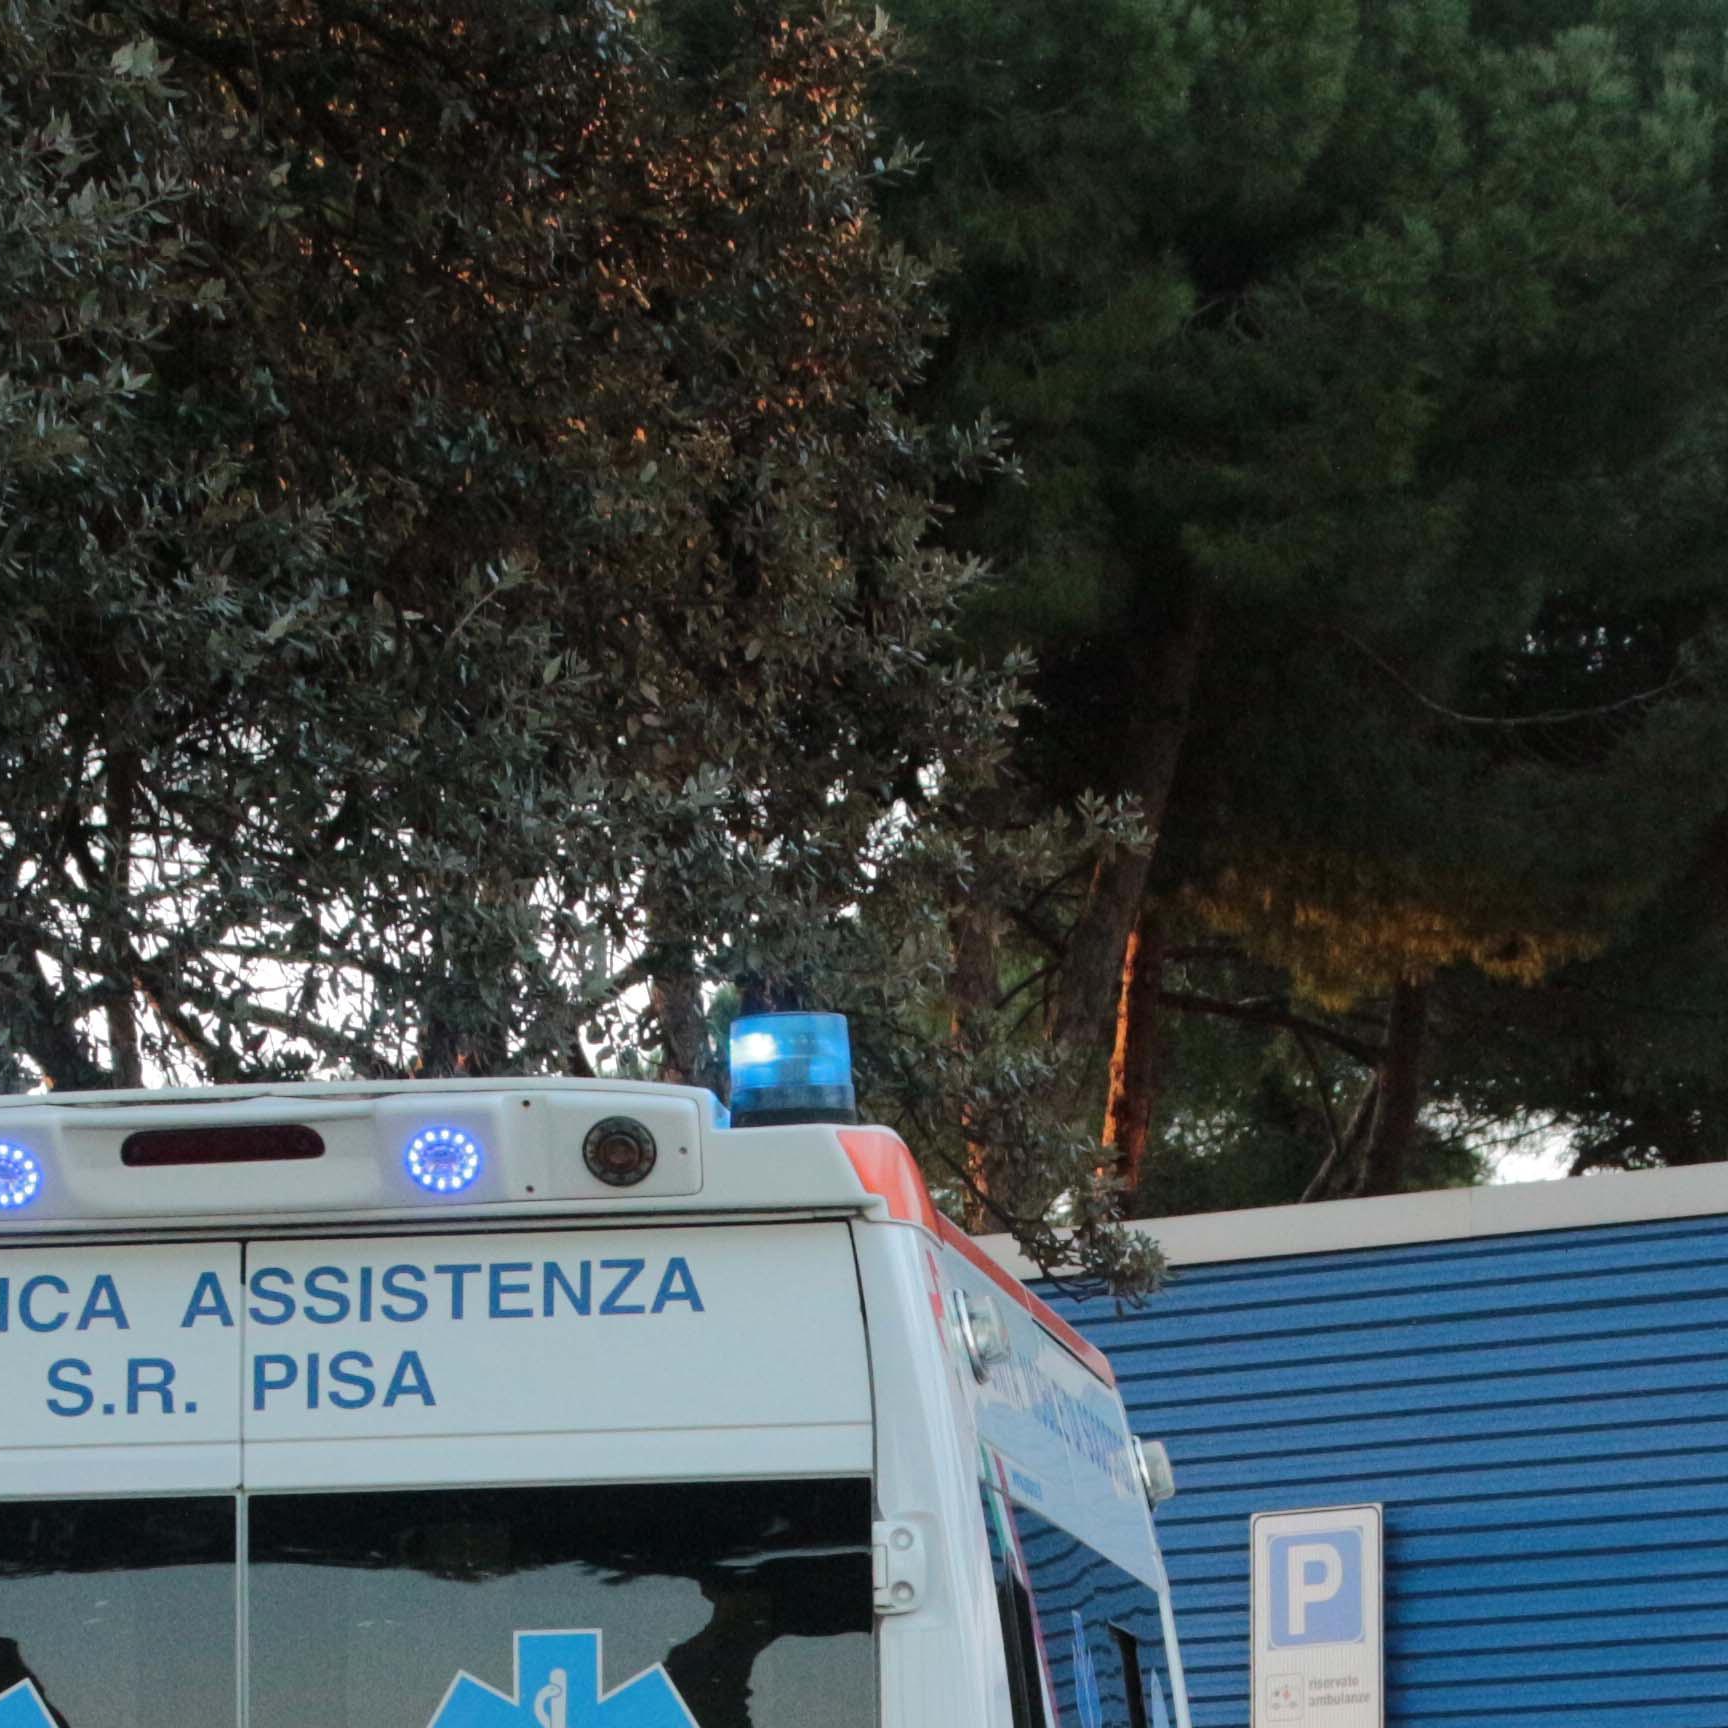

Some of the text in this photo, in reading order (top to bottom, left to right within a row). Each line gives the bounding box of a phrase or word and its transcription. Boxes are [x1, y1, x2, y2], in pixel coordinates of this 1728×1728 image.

[180, 1255, 706, 1329] ASSISTENZA
[46, 1348, 438, 1418] S.R. PISA
[1287, 1543, 1344, 1636] P
